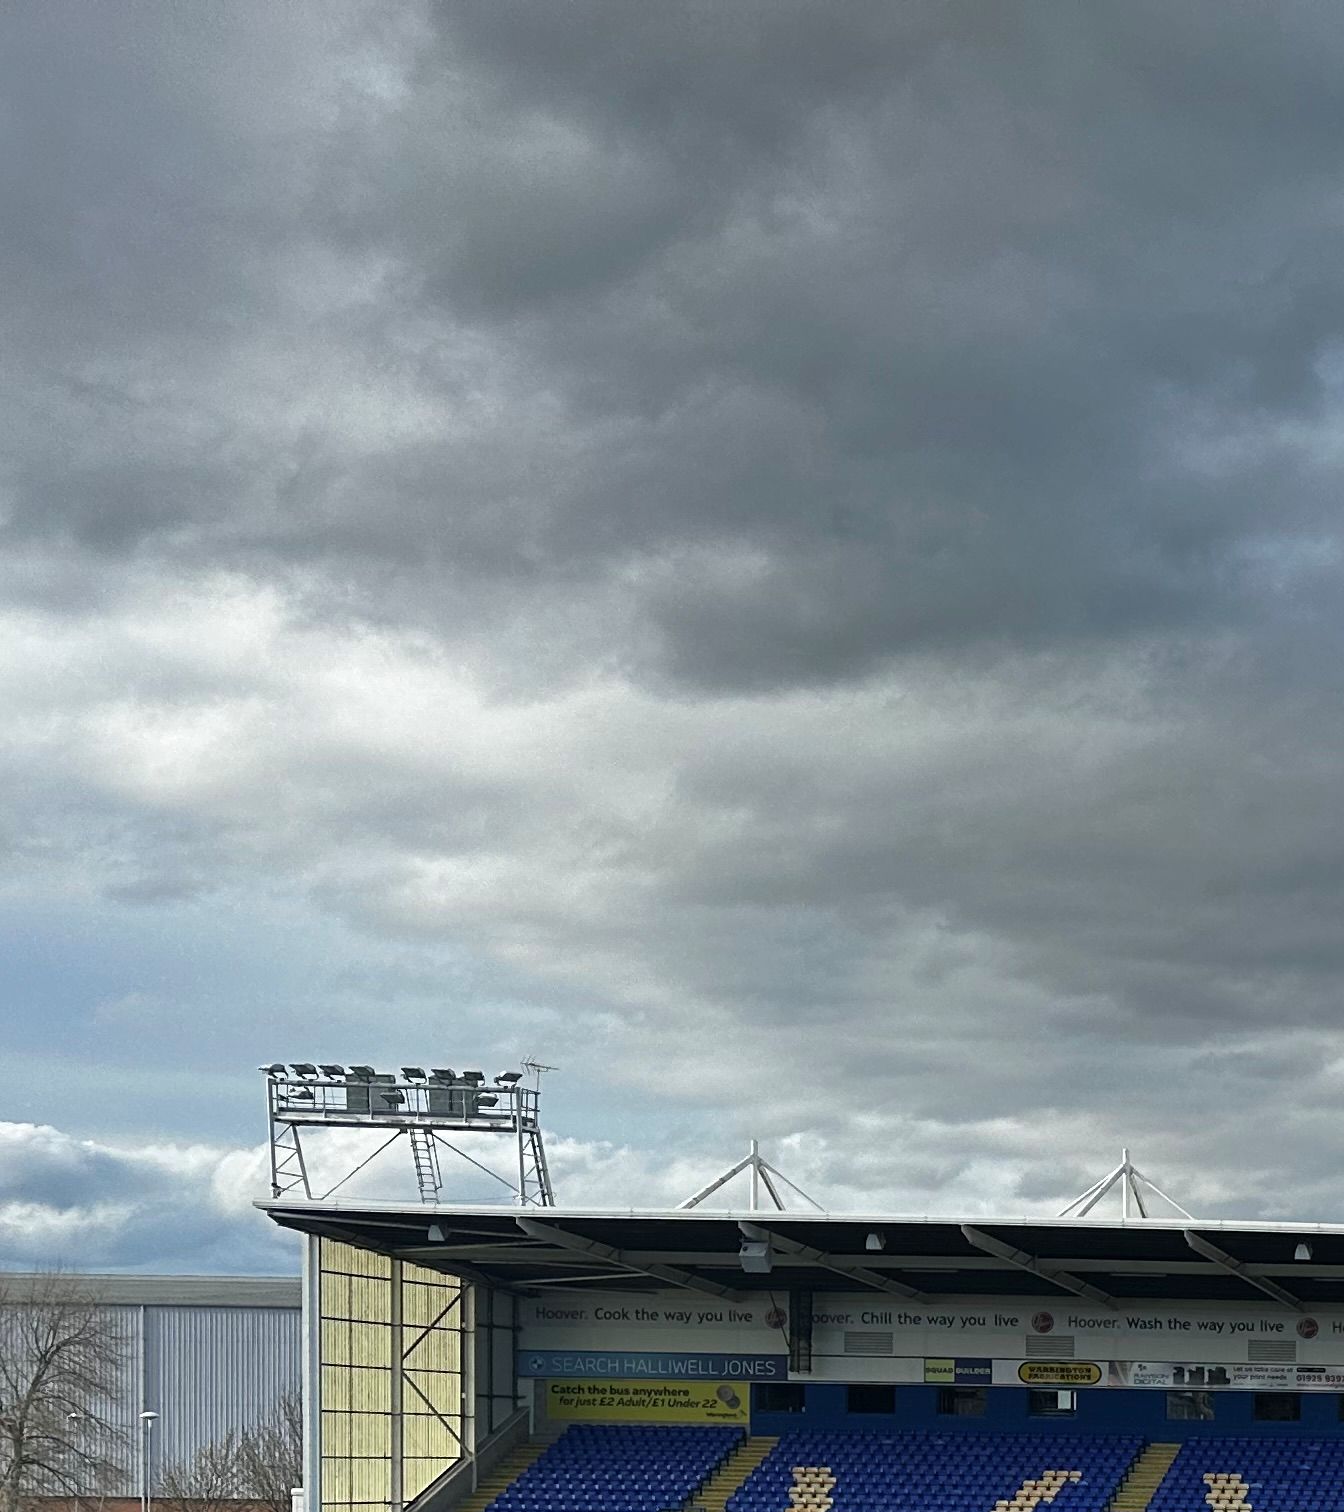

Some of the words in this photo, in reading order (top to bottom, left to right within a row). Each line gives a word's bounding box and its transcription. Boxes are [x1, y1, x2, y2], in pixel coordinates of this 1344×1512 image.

[594, 1307, 629, 1321] Cook
[635, 1308, 659, 1321] the
[664, 1311, 691, 1324] way
[698, 1311, 723, 1324] you
[728, 1309, 753, 1322] live
[861, 1312, 892, 1325] Chill
[898, 1312, 922, 1325] the
[927, 1315, 954, 1328] way
[960, 1316, 985, 1328] you
[994, 1314, 1019, 1327] live
[1126, 1317, 1163, 1330] Wash
[1168, 1317, 1191, 1331] the
[1197, 1321, 1224, 1334] way
[1229, 1322, 1254, 1334] you
[1260, 1320, 1284, 1333] live
[552, 1357, 620, 1373] SEARCH
[623, 1359, 720, 1376] HALLIWELL
[722, 1360, 777, 1377] JONES
[551, 1385, 586, 1396] Catch
[587, 1385, 606, 1396] the
[607, 1385, 630, 1397] bus
[632, 1387, 690, 1399] anywhere
[559, 1396, 573, 1407] for
[574, 1397, 597, 1408] just
[667, 1399, 700, 1409] Under
[702, 1399, 717, 1409] 22
